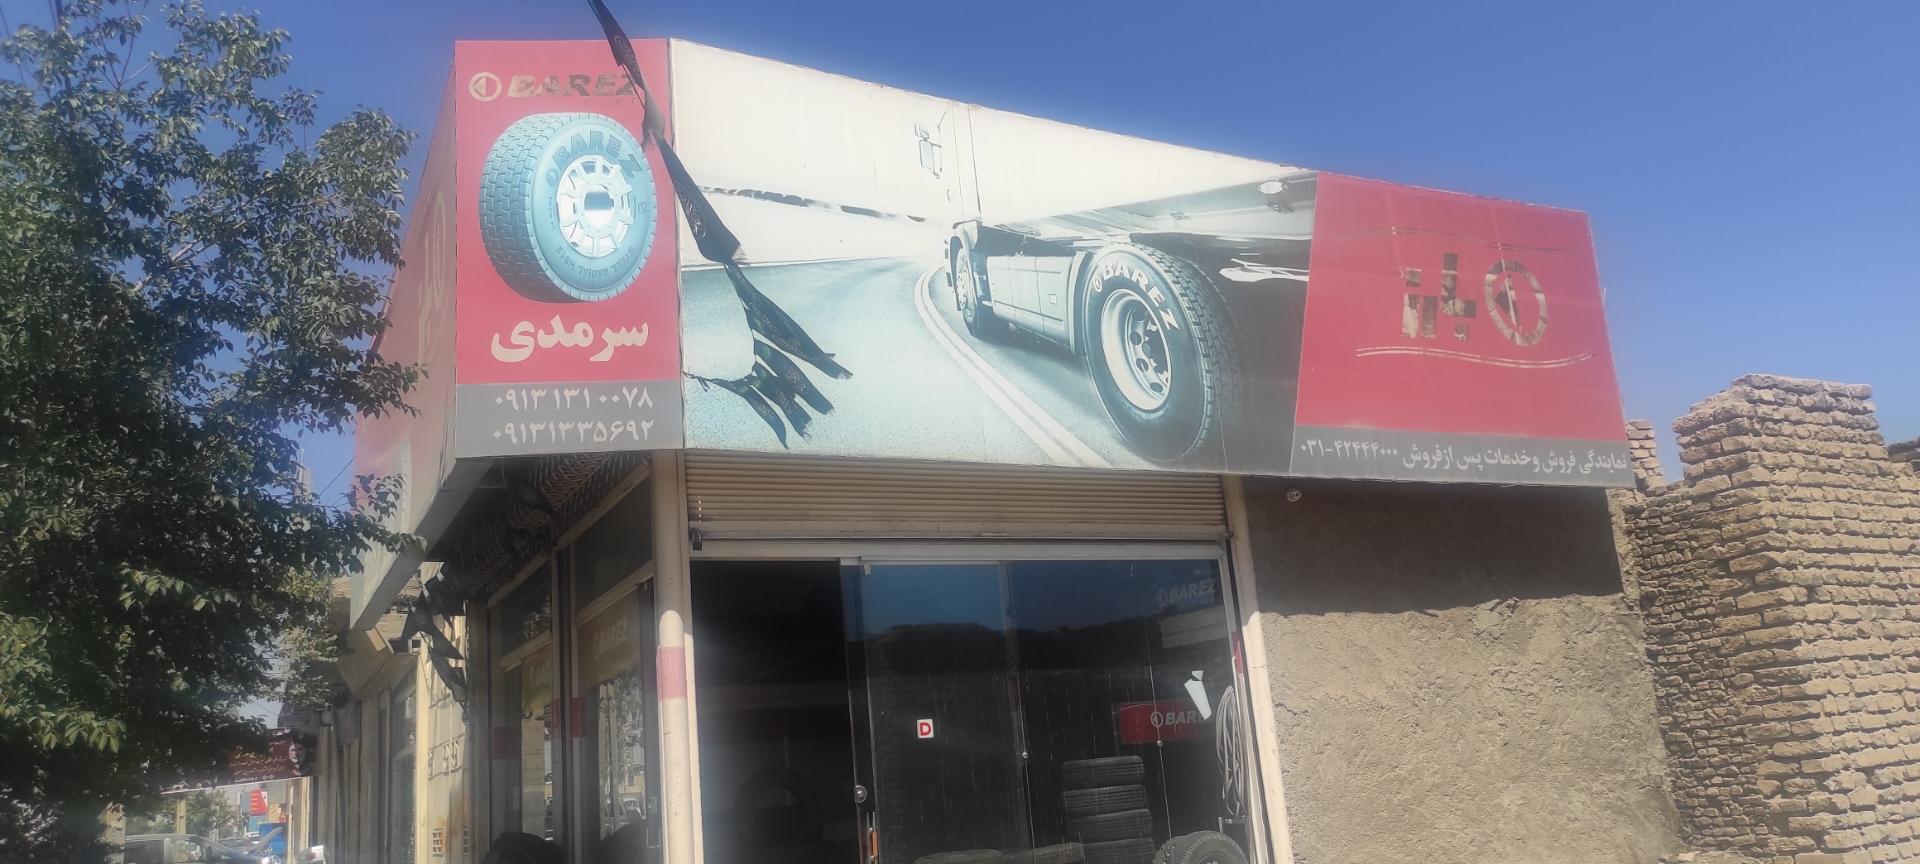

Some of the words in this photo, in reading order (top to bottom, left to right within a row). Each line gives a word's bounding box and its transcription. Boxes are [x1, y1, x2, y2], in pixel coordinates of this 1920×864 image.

[552, 130, 642, 178] BAREZ
[1102, 261, 1180, 330] BAREZ
[491, 314, 649, 363] سرمدی
[1456, 450, 1482, 472] پس
[1542, 448, 1576, 474] فروش
[1578, 449, 1628, 474] نمایندگی
[919, 721, 932, 736] D
